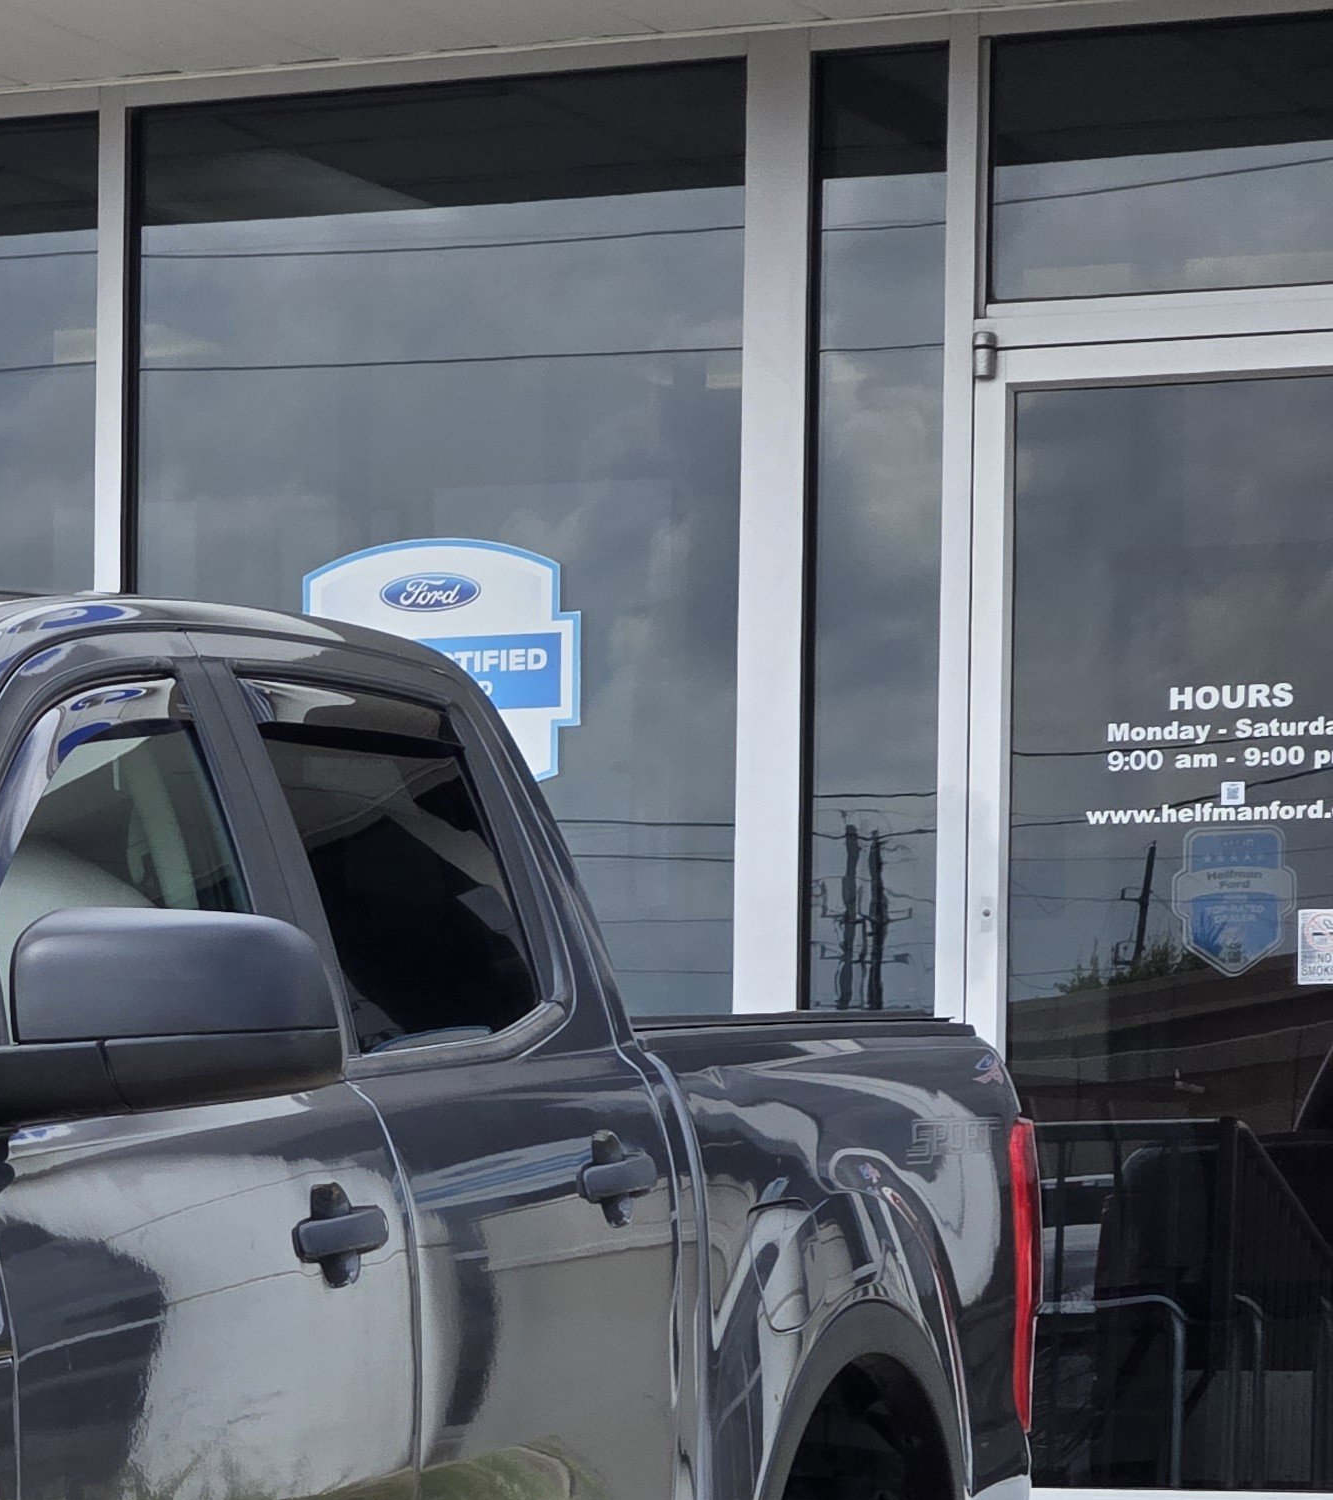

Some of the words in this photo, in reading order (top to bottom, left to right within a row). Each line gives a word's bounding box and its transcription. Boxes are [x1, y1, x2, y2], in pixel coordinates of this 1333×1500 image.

[400, 579, 460, 606] Ford
[444, 648, 548, 672] TIFIED
[1169, 683, 1294, 711] HOURS
[1107, 721, 1211, 744] Monday
[1107, 750, 1164, 772] 9:00
[1174, 753, 1218, 769] am
[1244, 746, 1305, 767] 9:00
[1314, 749, 1333, 769] p
[1086, 800, 1333, 824] www.helfmanford.
[1206, 869, 1263, 881] Helfman
[1219, 880, 1251, 889] Ford
[1317, 952, 1332, 963] NO
[905, 1115, 1001, 1165] SPORT
